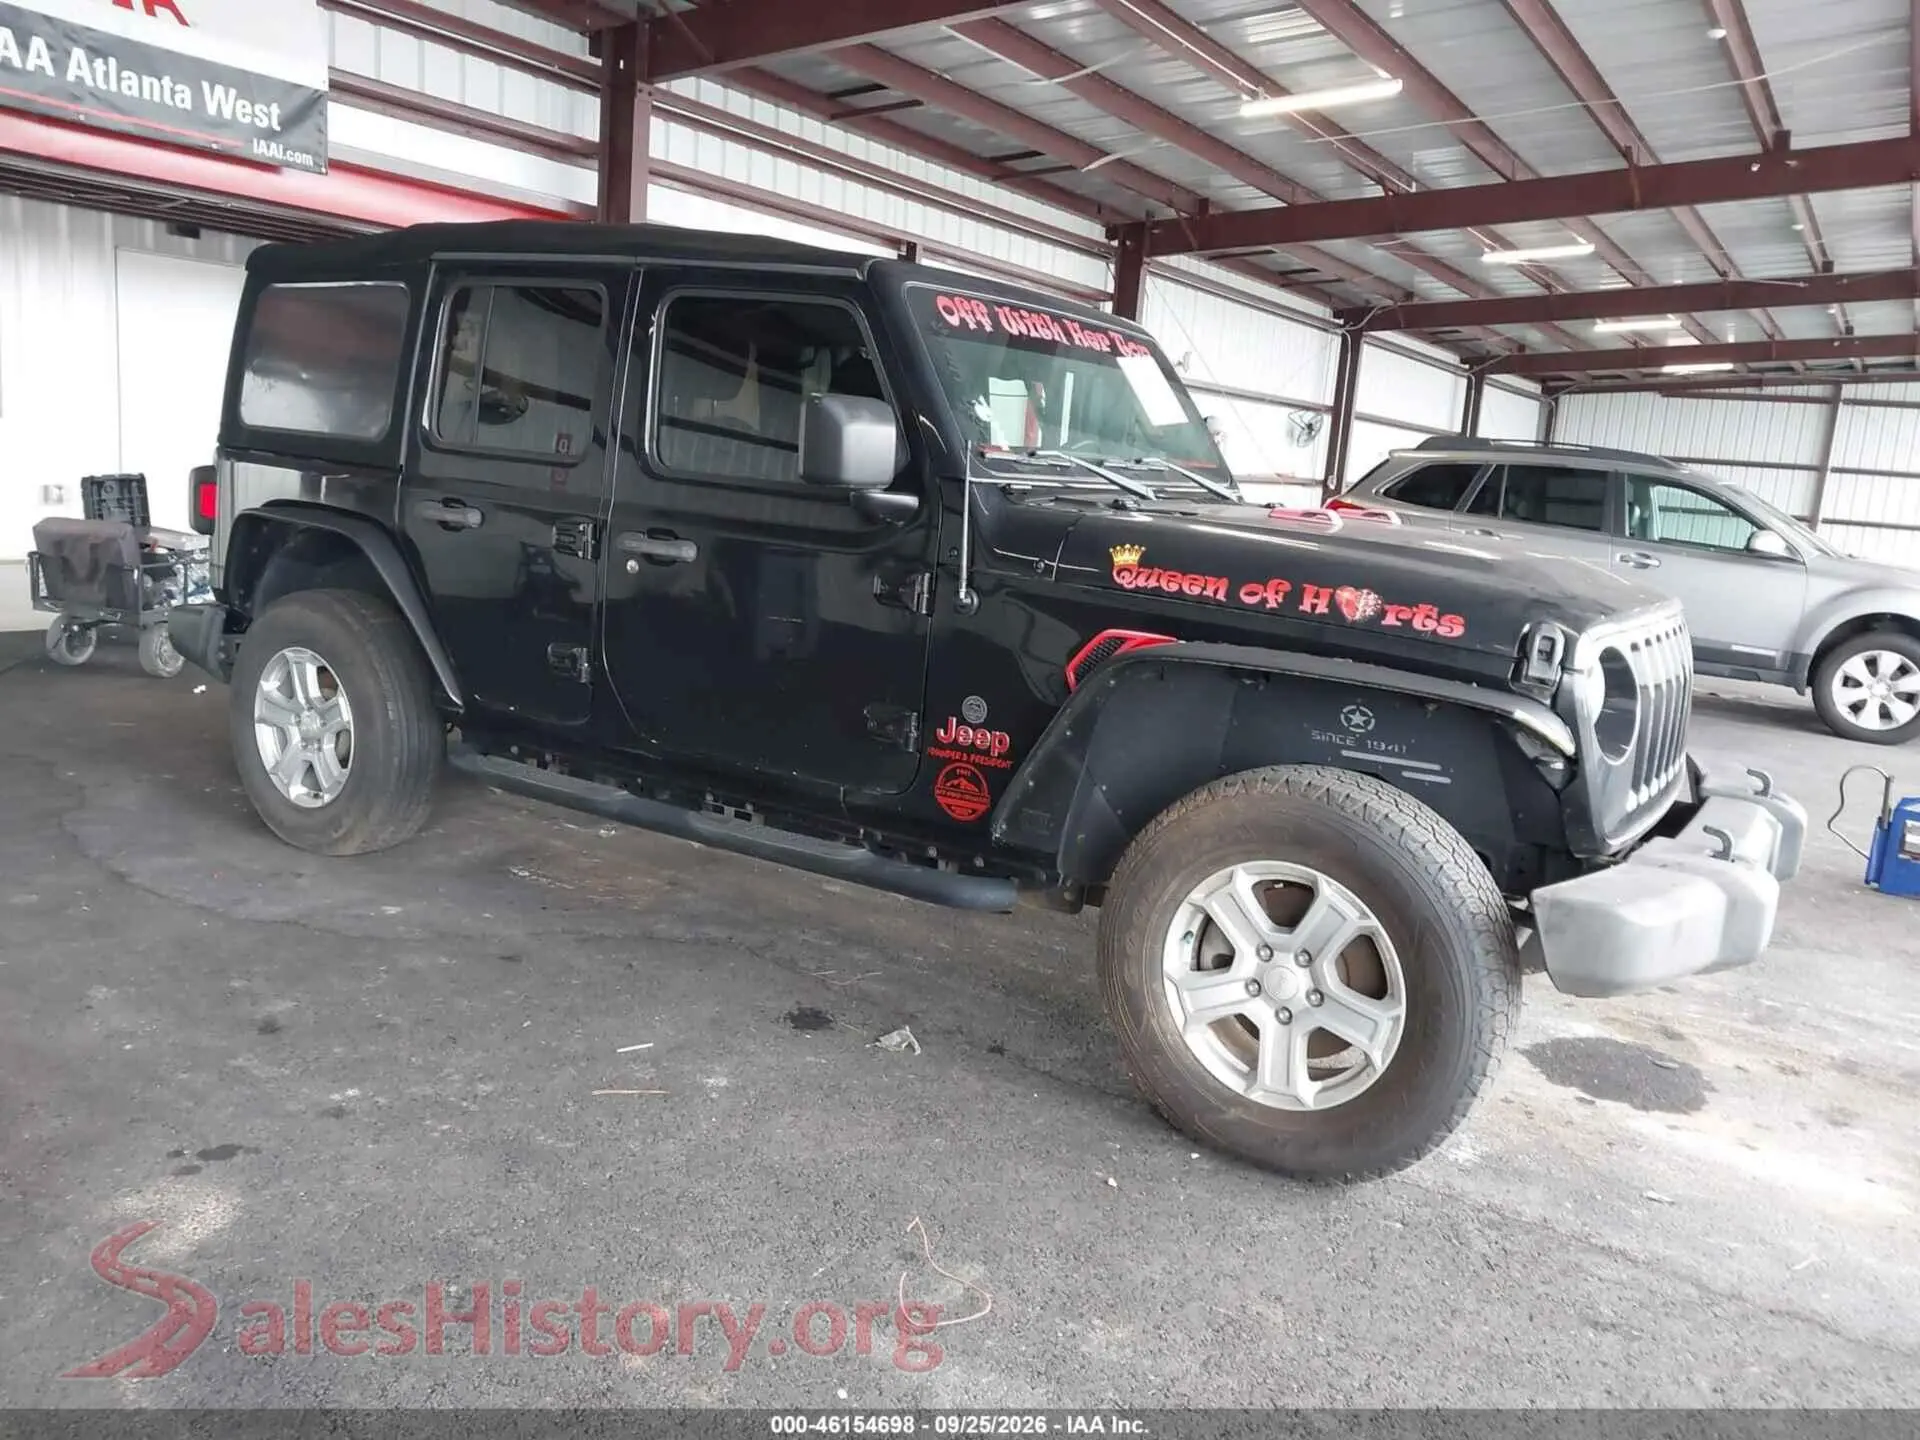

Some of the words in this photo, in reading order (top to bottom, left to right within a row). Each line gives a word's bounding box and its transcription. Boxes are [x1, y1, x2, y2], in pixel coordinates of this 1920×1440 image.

[66, 47, 192, 111] Atlanta
[201, 80, 281, 131] West
[252, 137, 314, 167] IAAI.com
[936, 294, 994, 333] Off
[993, 305, 1071, 346] With
[1062, 318, 1112, 353] Her
[1111, 563, 1230, 602] Queen
[1239, 578, 1292, 609] of
[936, 716, 1010, 757] Jeep
